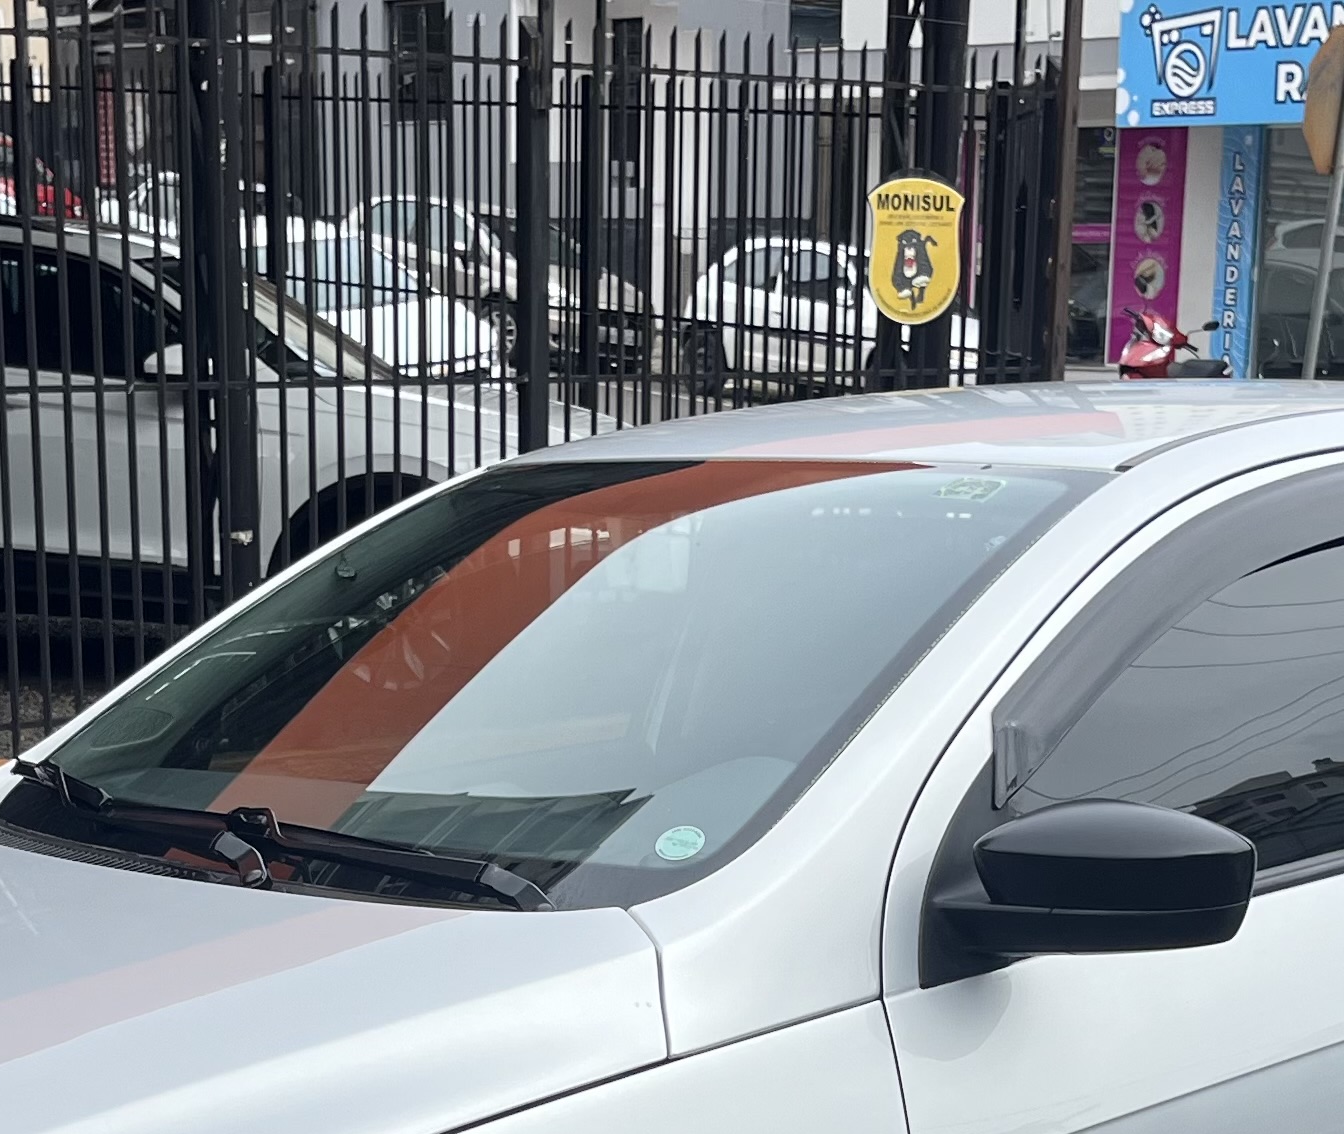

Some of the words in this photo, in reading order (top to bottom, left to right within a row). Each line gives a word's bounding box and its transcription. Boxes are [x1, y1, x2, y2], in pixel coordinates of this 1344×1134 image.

[1152, 100, 1214, 116] EXPRESS
[877, 193, 955, 211] MONISUL
[1222, 153, 1245, 375] LAVANDERIA
